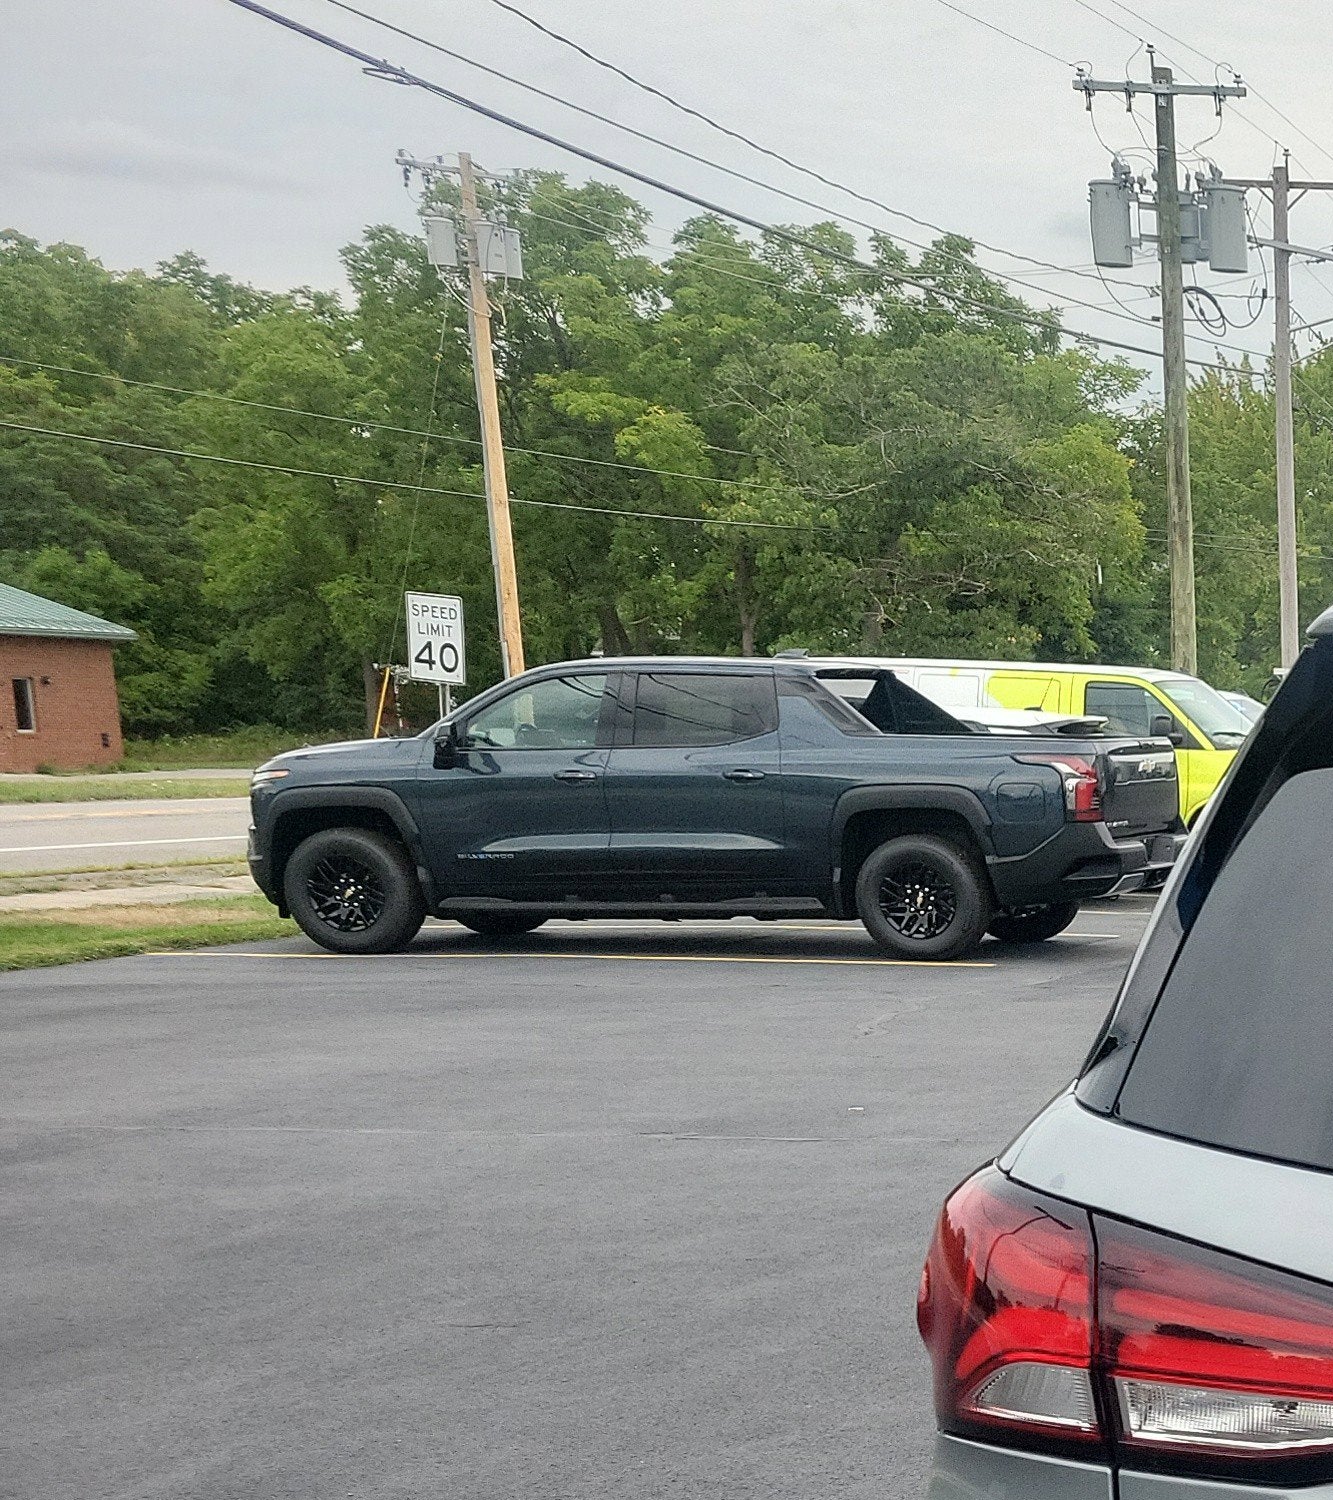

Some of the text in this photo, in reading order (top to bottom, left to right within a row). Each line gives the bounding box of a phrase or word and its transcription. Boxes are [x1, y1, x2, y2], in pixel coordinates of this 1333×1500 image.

[411, 603, 458, 620] SPEED
[417, 622, 453, 637] LIMIT
[414, 640, 459, 673] 40
